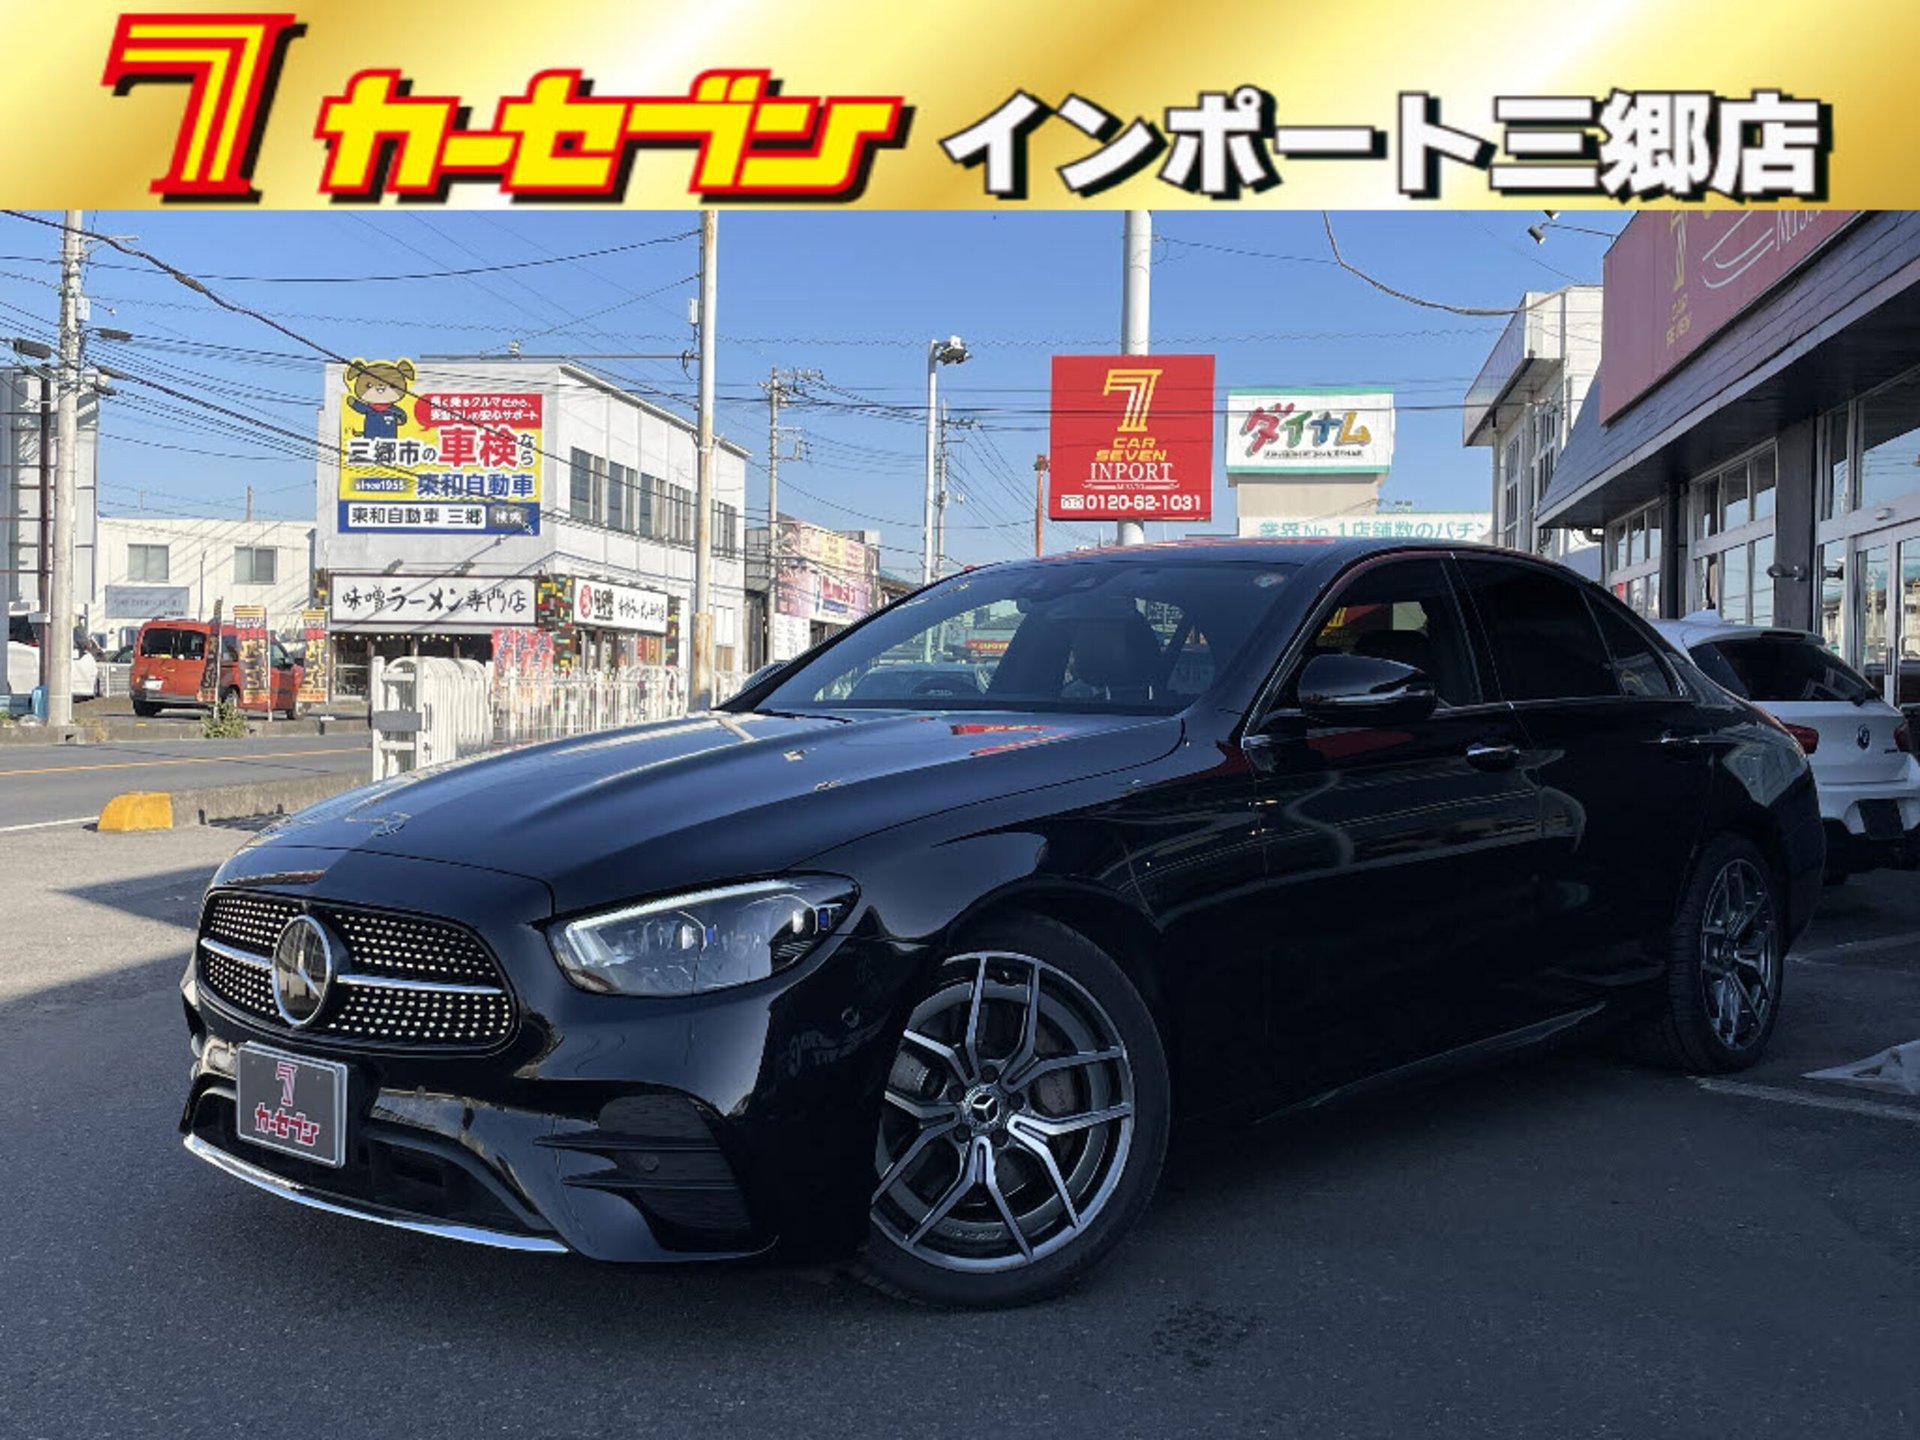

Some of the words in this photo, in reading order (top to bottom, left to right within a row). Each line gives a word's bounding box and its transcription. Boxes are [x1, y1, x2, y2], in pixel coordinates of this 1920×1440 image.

[1239, 403, 1372, 457] ダイナム
[1112, 437, 1156, 449] CAR
[1095, 449, 1167, 462] SEVEN
[1089, 462, 1173, 480] INPORT
[1086, 494, 1200, 510] 0120-62-1031
[447, 508, 483, 525] 三郷
[342, 585, 527, 614] 味噌ラーメン専門店
